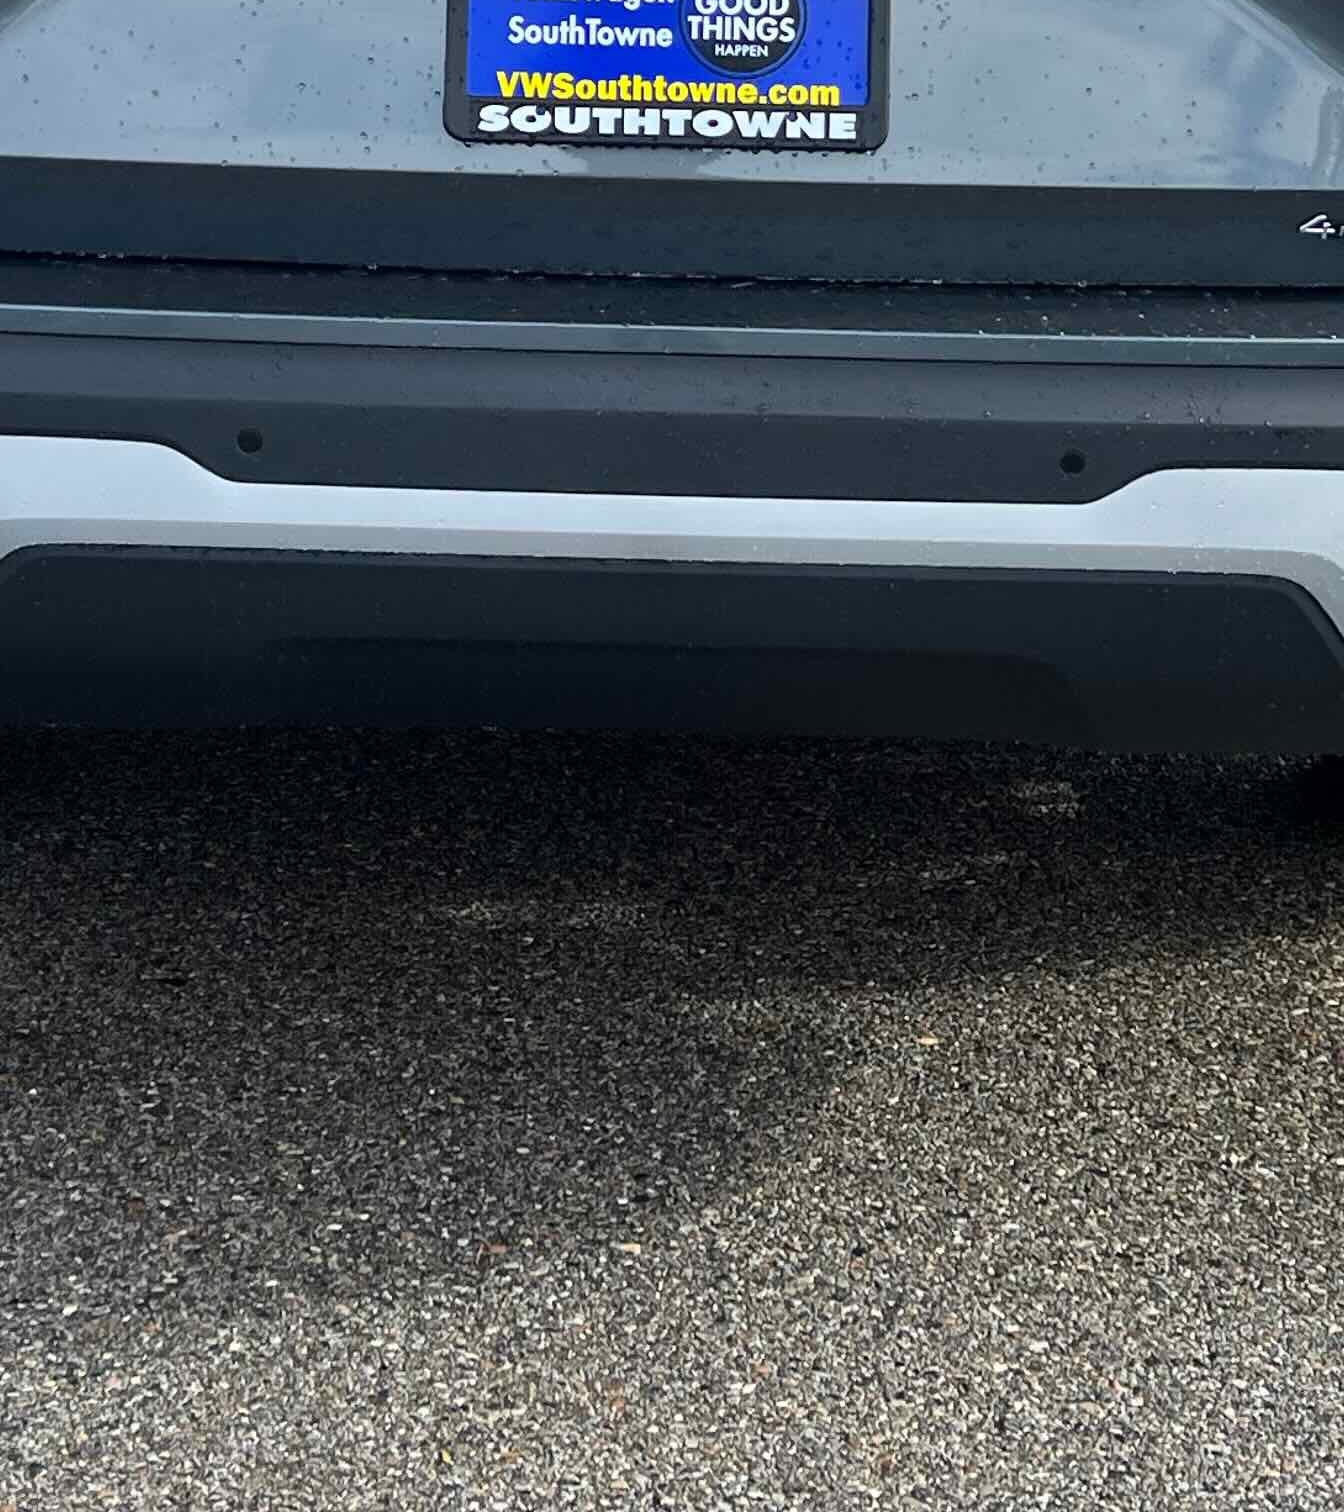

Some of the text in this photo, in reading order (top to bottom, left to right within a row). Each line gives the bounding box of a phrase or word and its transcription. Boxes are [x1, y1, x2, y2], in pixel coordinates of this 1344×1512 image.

[507, 15, 674, 48] SouthTowne
[687, 15, 796, 43] THINGS
[714, 43, 769, 57] HAPPEN
[496, 70, 841, 106] VWSouthtowne.com
[477, 104, 858, 141] SOUTHTOWNE
